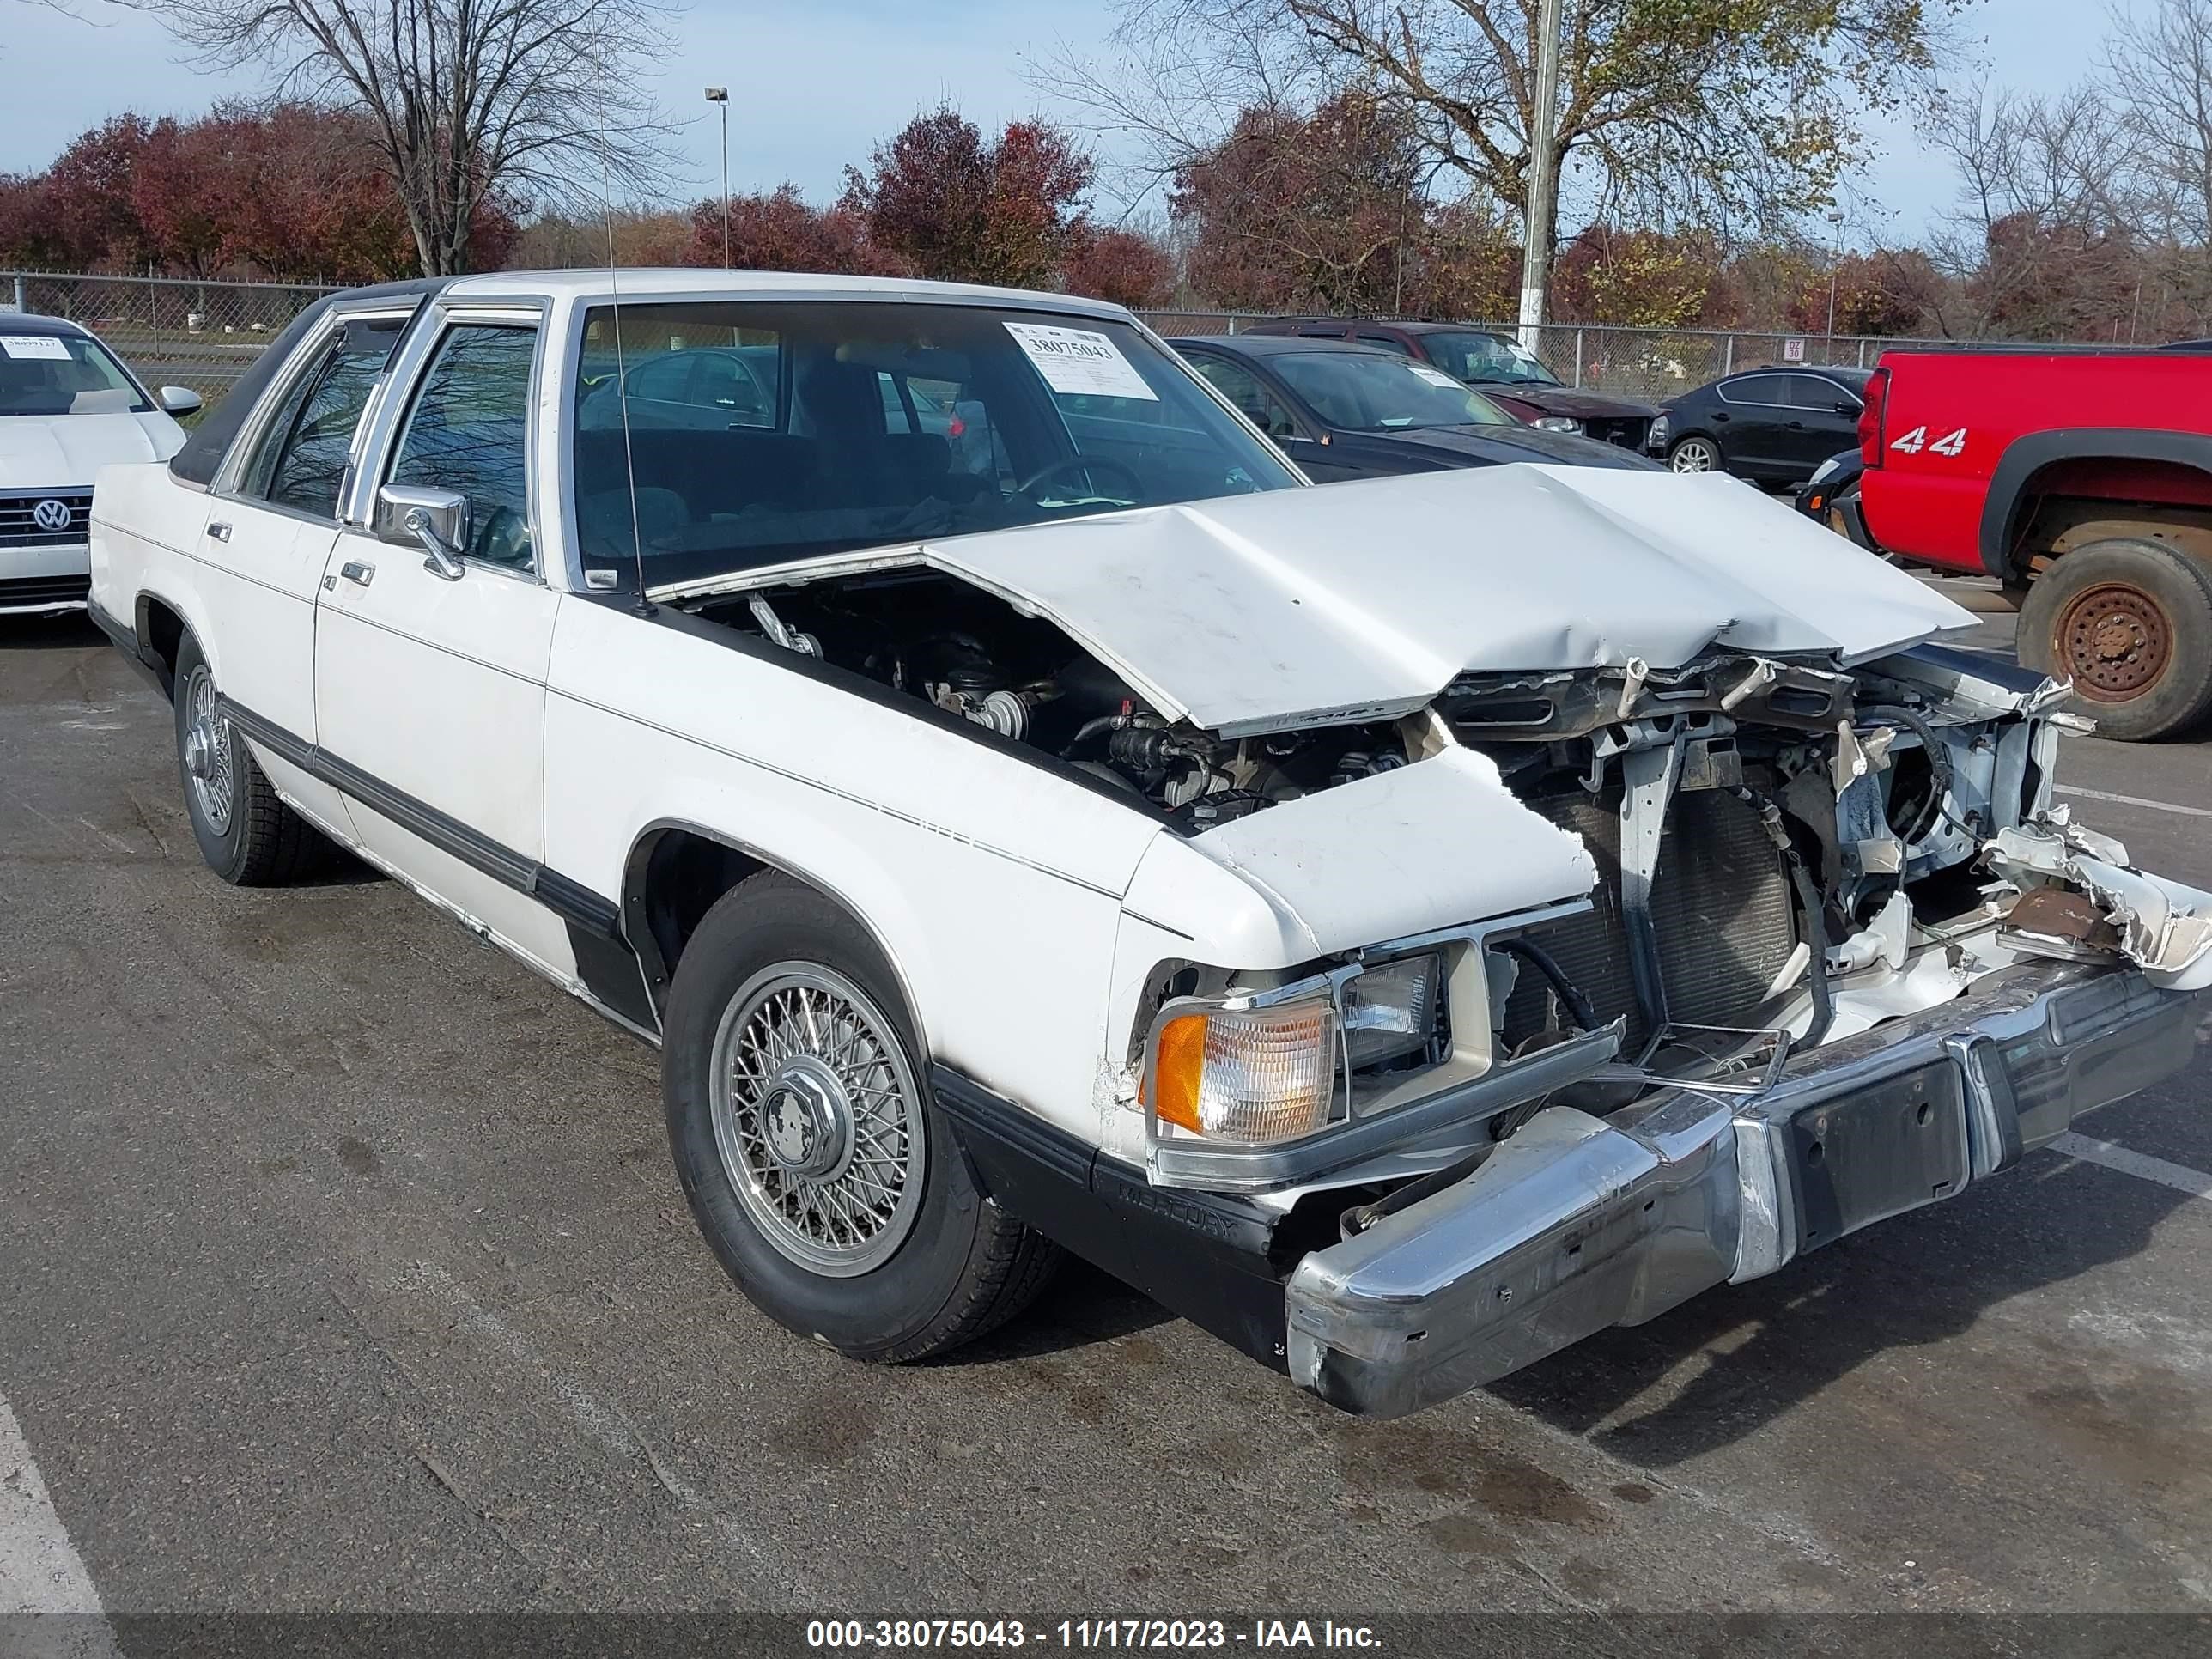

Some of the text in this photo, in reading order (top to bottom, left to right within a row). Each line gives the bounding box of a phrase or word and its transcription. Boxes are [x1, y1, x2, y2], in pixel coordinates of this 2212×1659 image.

[1028, 338, 1114, 361] 38075043
[1789, 341, 1801, 349] DZ
[1789, 349, 1800, 358] 30
[1119, 1182, 1237, 1238] MERCURY
